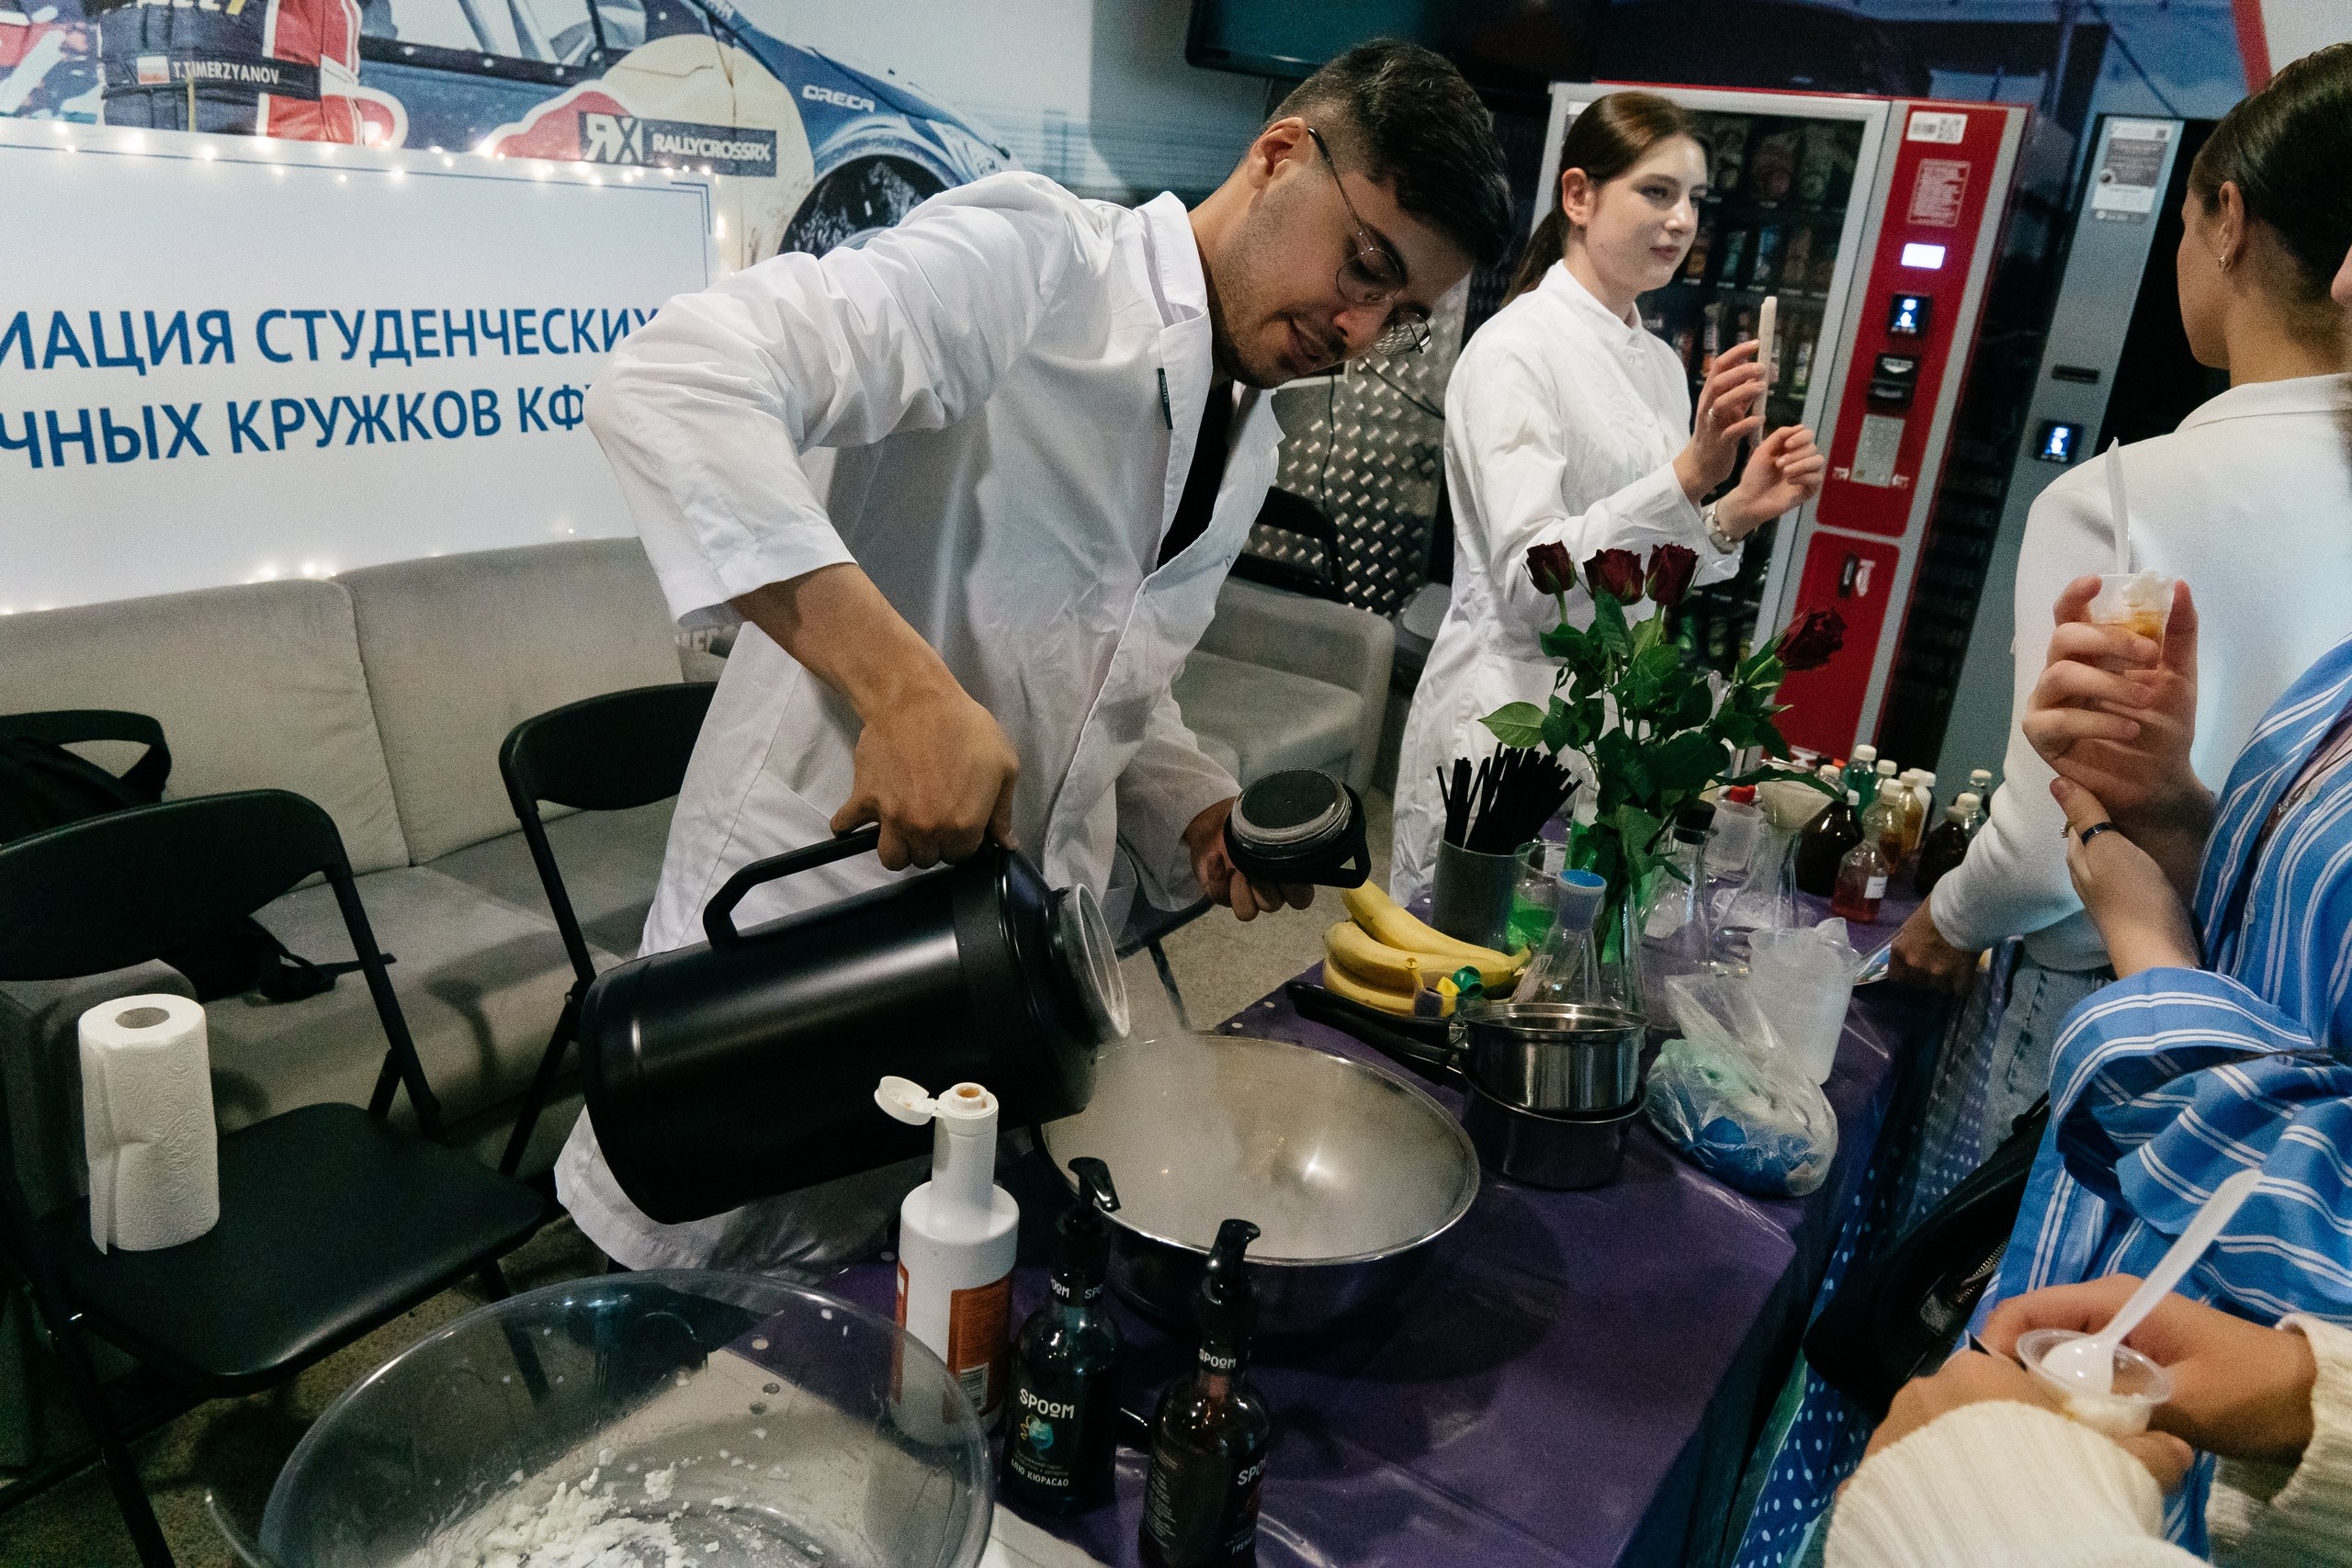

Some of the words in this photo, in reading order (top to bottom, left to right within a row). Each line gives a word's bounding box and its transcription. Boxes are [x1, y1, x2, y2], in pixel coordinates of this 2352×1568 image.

[651, 132, 772, 162] RALLYCROSSRX
[0, 402, 210, 469] ЧНЫХ
[226, 389, 502, 454] КРУЖКОВ
[517, 384, 592, 433] КФ
[1027, 1471, 1069, 1487] КЮРАСАО
